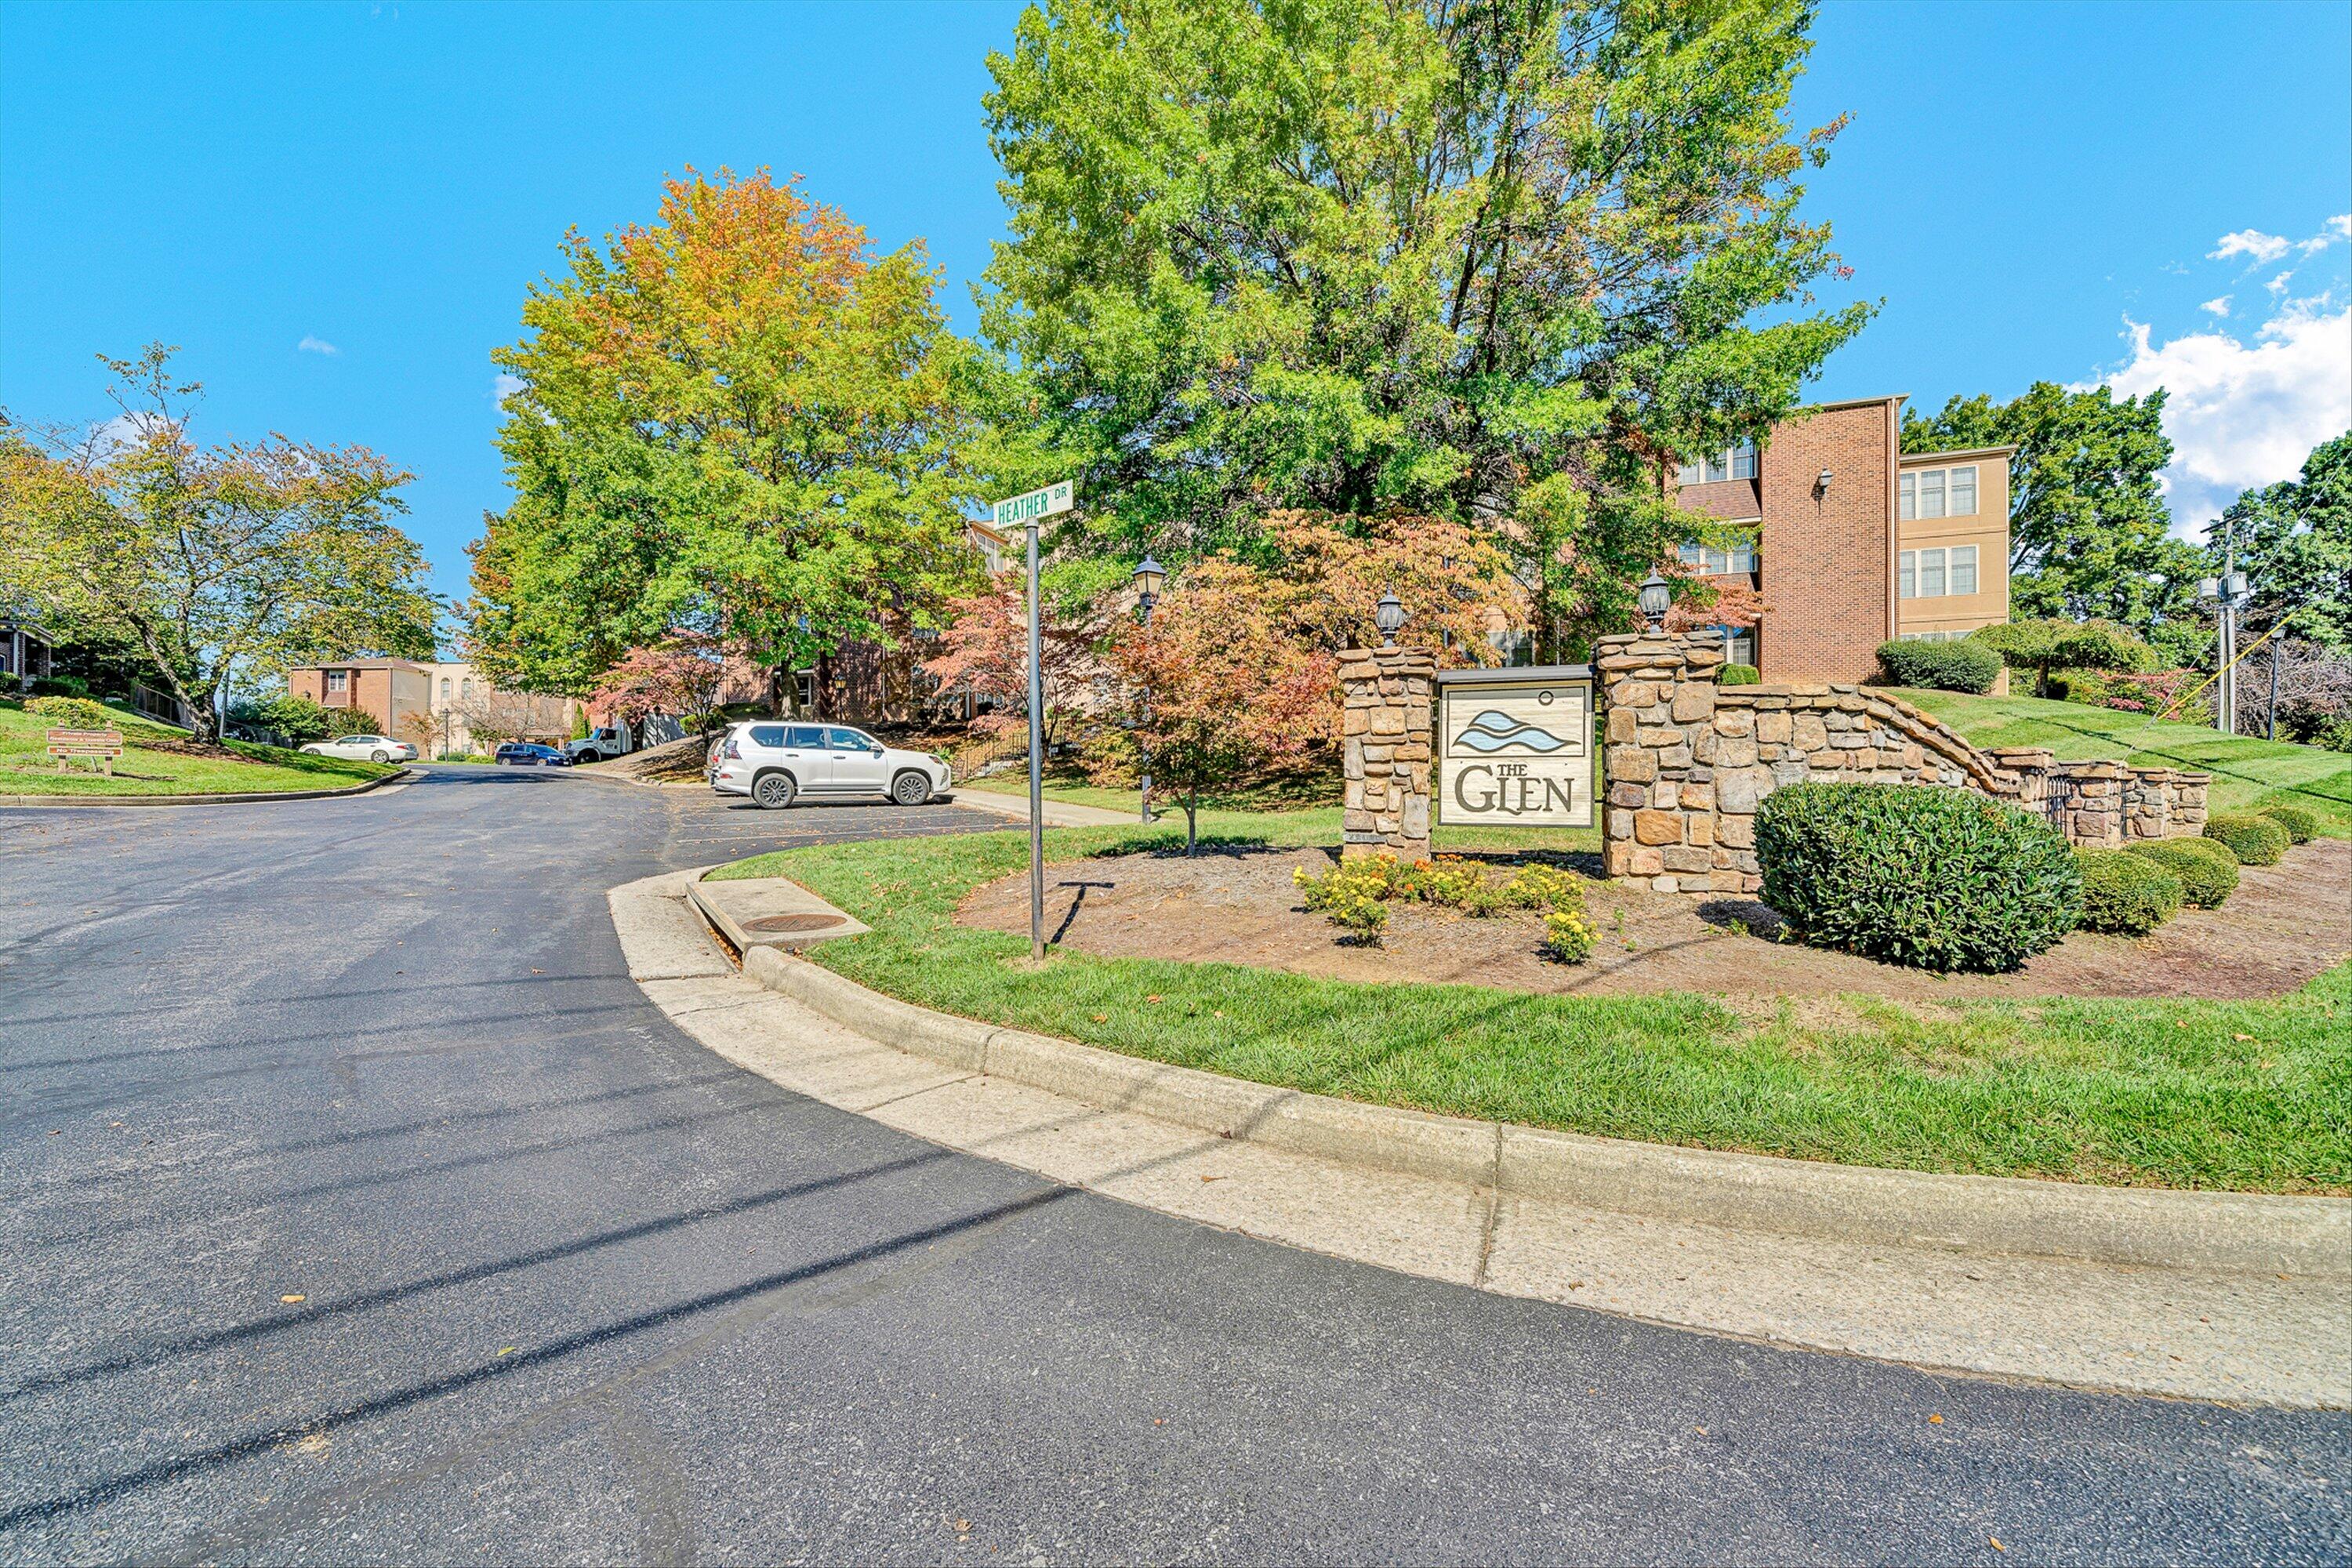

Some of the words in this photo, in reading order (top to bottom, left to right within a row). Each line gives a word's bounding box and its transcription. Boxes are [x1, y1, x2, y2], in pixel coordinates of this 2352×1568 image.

[998, 492, 1048, 524] HEATHER
[1054, 486, 1067, 499] DR
[1497, 764, 1528, 776] THE
[1454, 764, 1575, 815] GLEN
